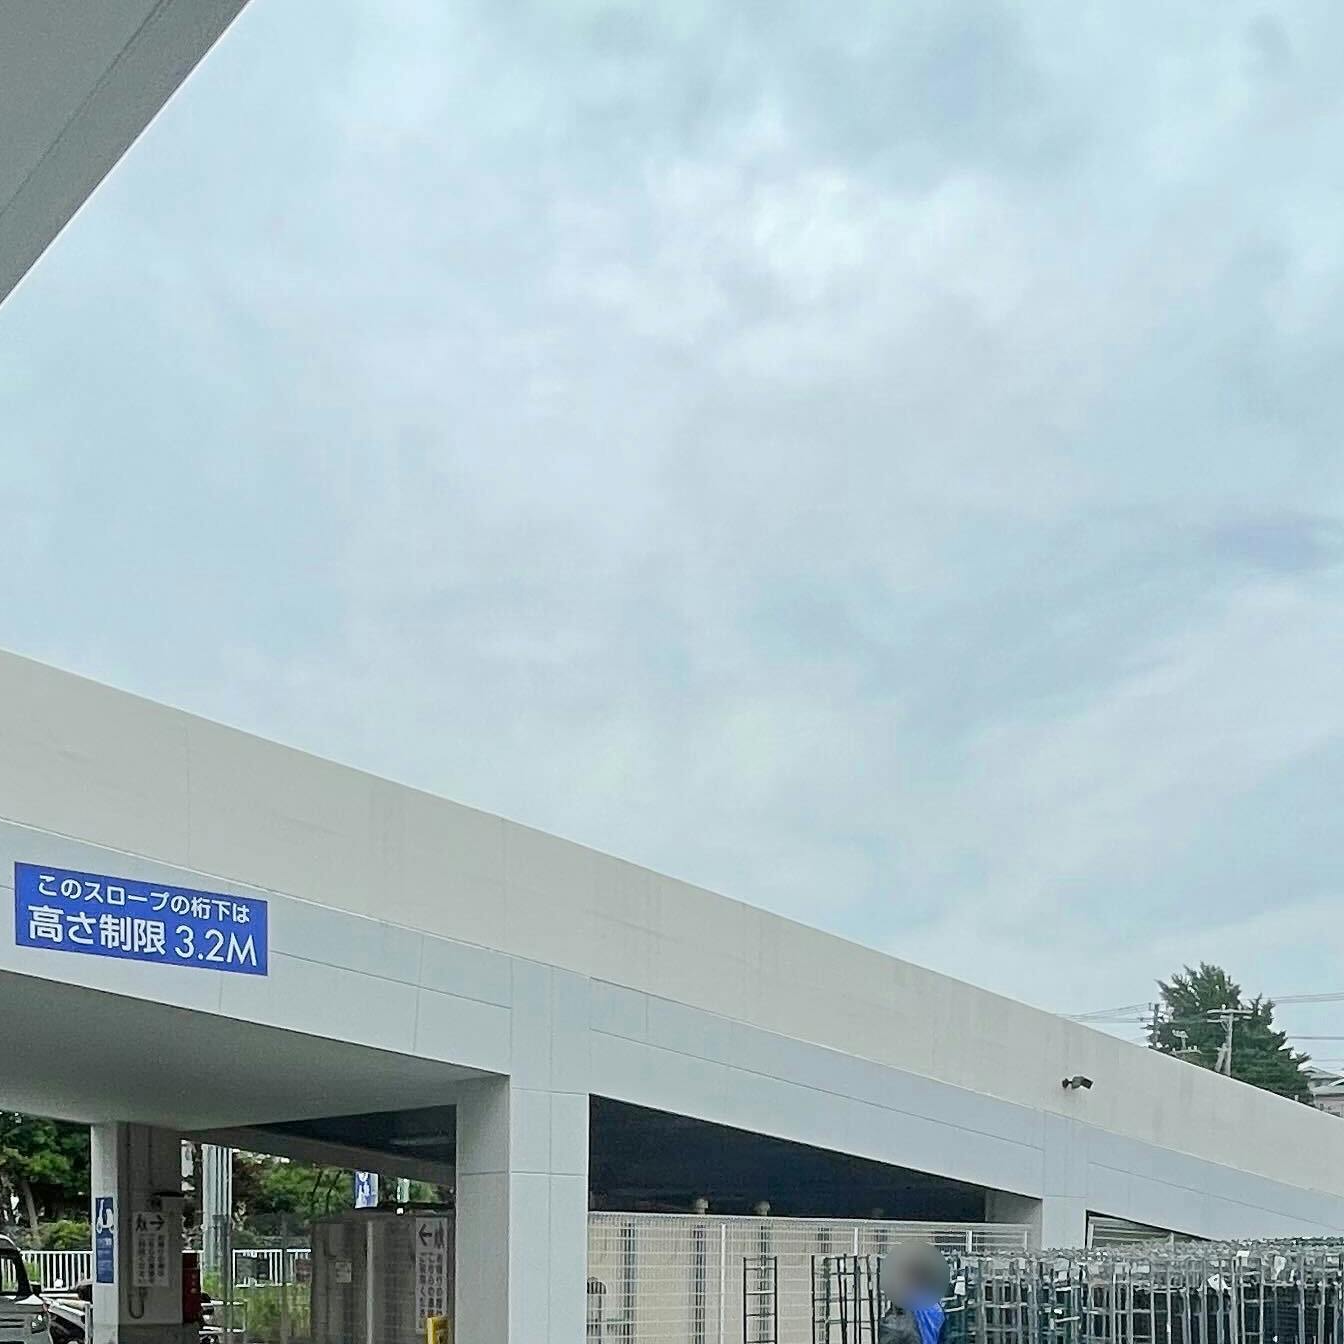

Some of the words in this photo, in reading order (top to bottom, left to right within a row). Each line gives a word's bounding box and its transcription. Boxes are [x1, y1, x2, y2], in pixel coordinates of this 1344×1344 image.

[37, 874, 250, 924] このスロープの桁下は
[27, 905, 167, 955] 高さ制限
[174, 926, 258, 967] 3.2M
